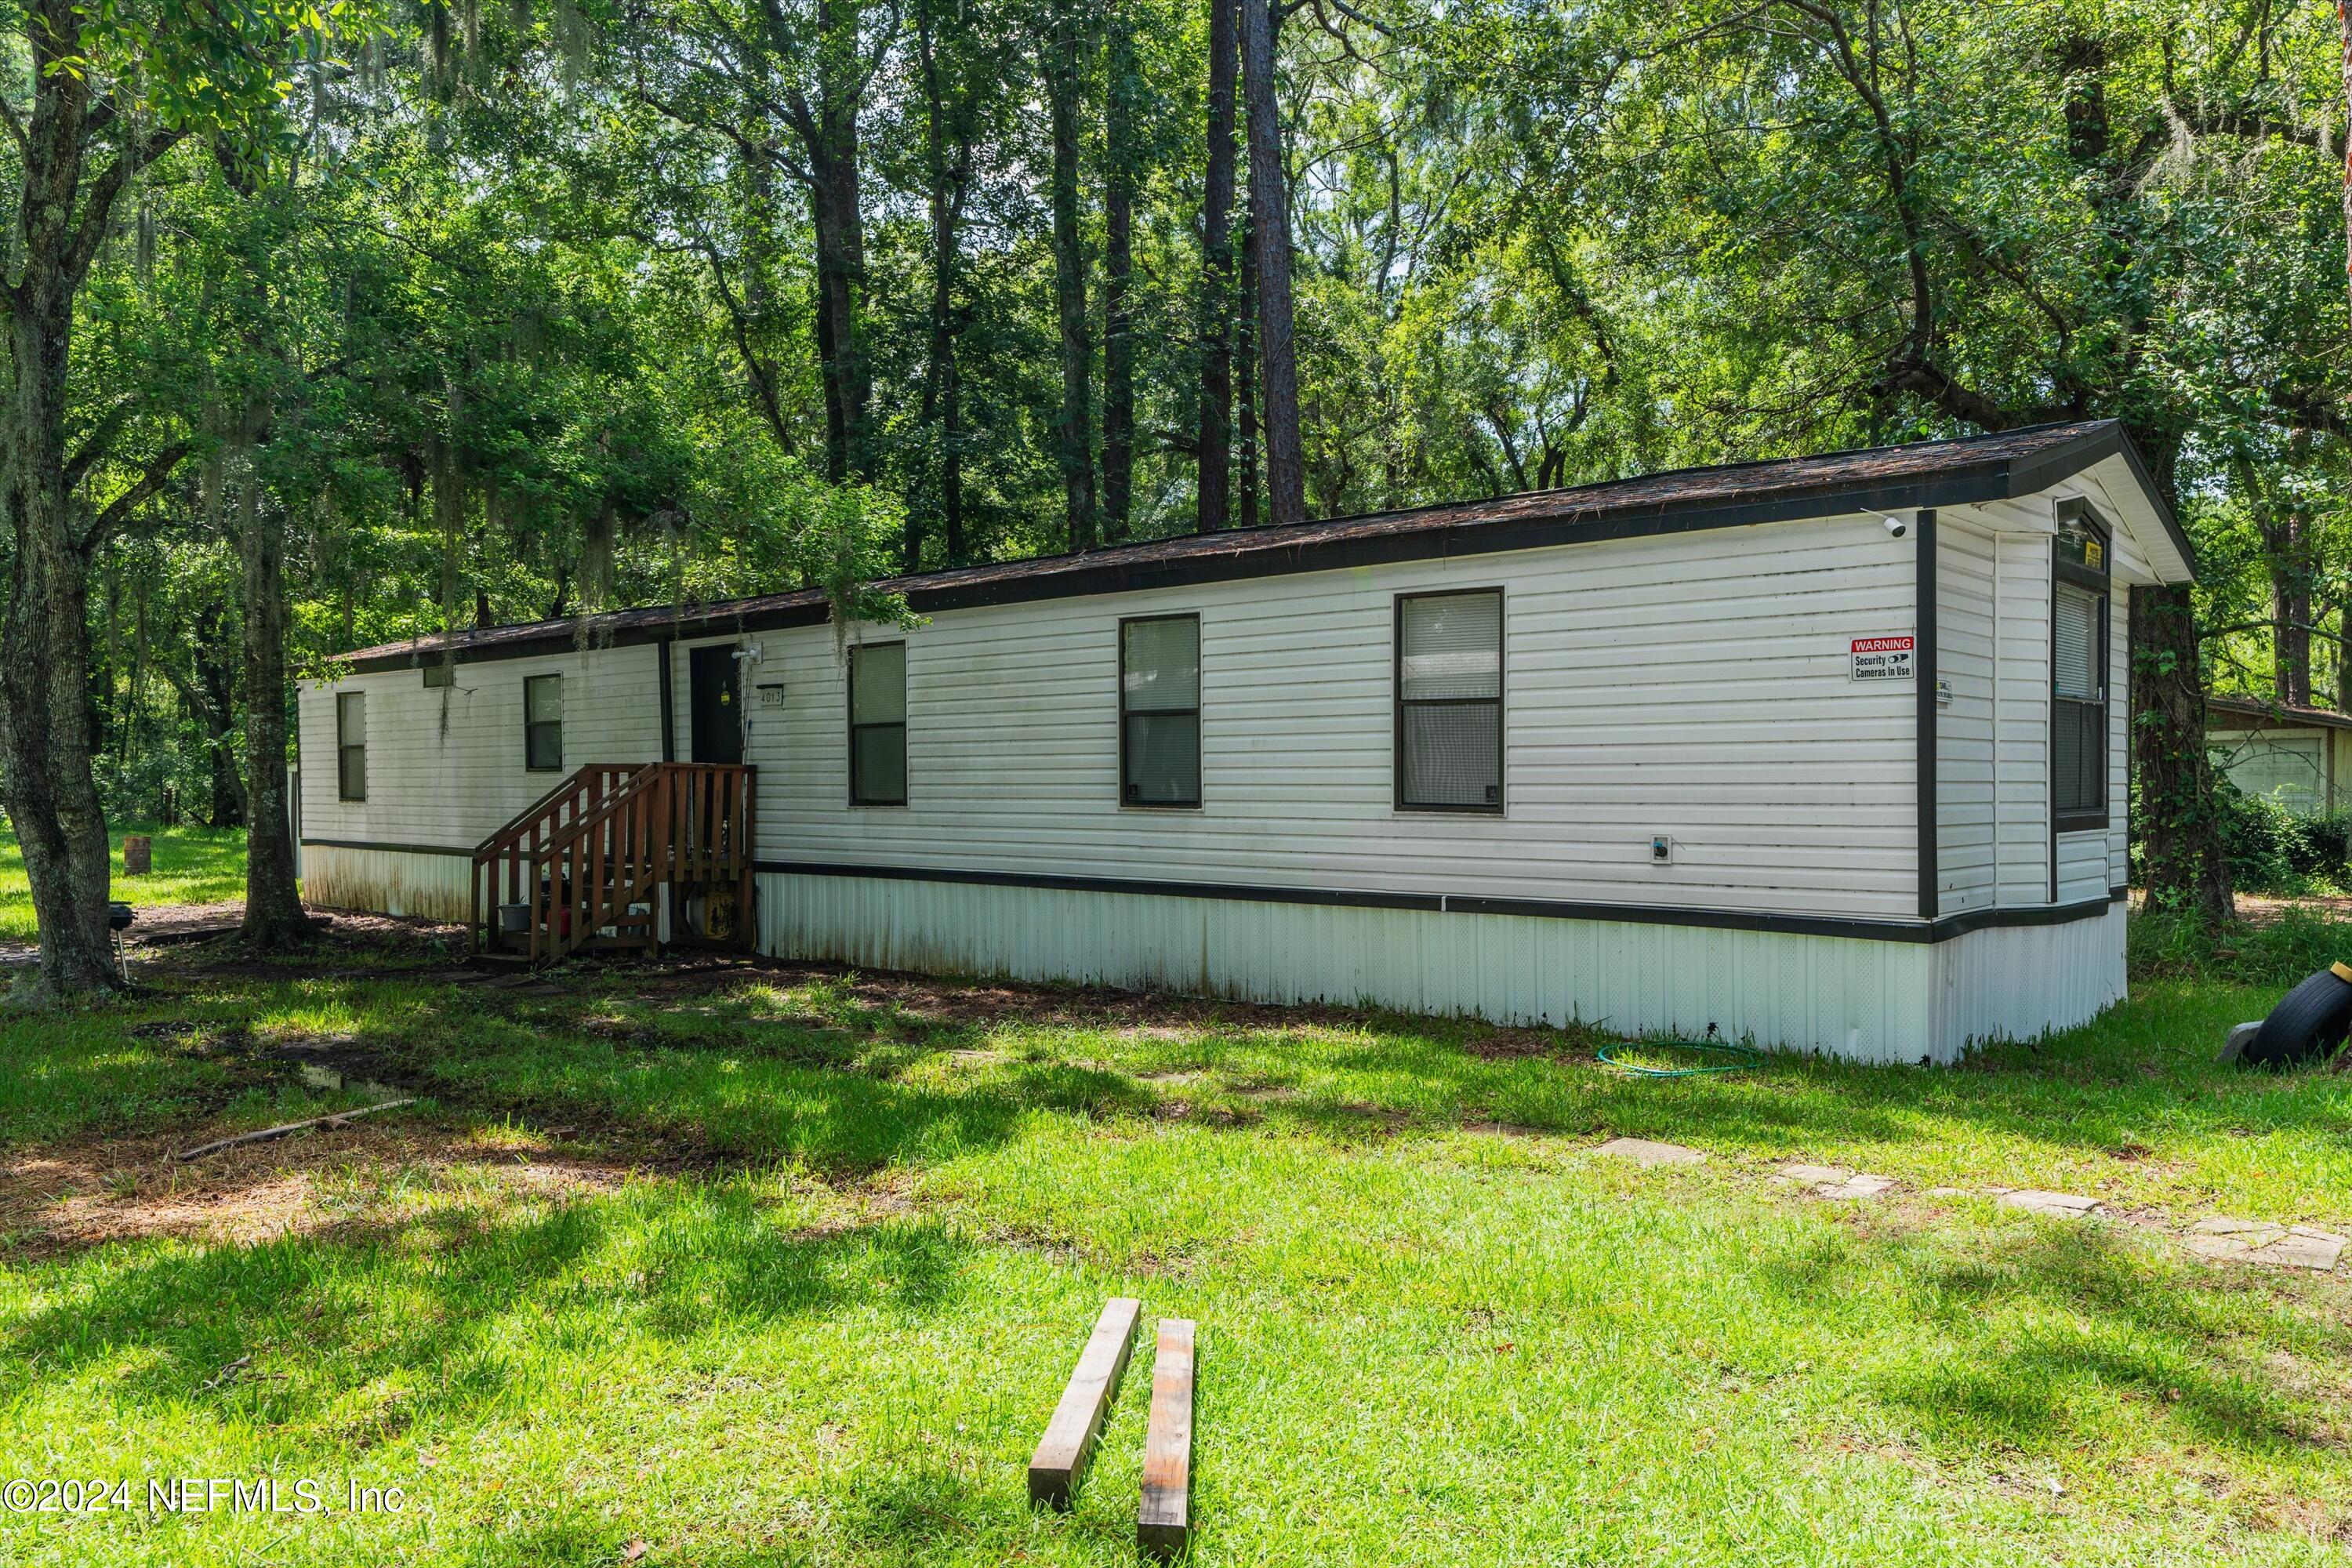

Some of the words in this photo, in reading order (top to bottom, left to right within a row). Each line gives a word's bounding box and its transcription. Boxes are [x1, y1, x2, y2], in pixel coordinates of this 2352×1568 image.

[1855, 638, 1911, 651] WARNING
[1856, 655, 1886, 666] Security
[1856, 667, 1886, 677] Cameras
[1888, 666, 1895, 676] In
[1896, 666, 1910, 675] Use
[760, 691, 780, 702] 4013
